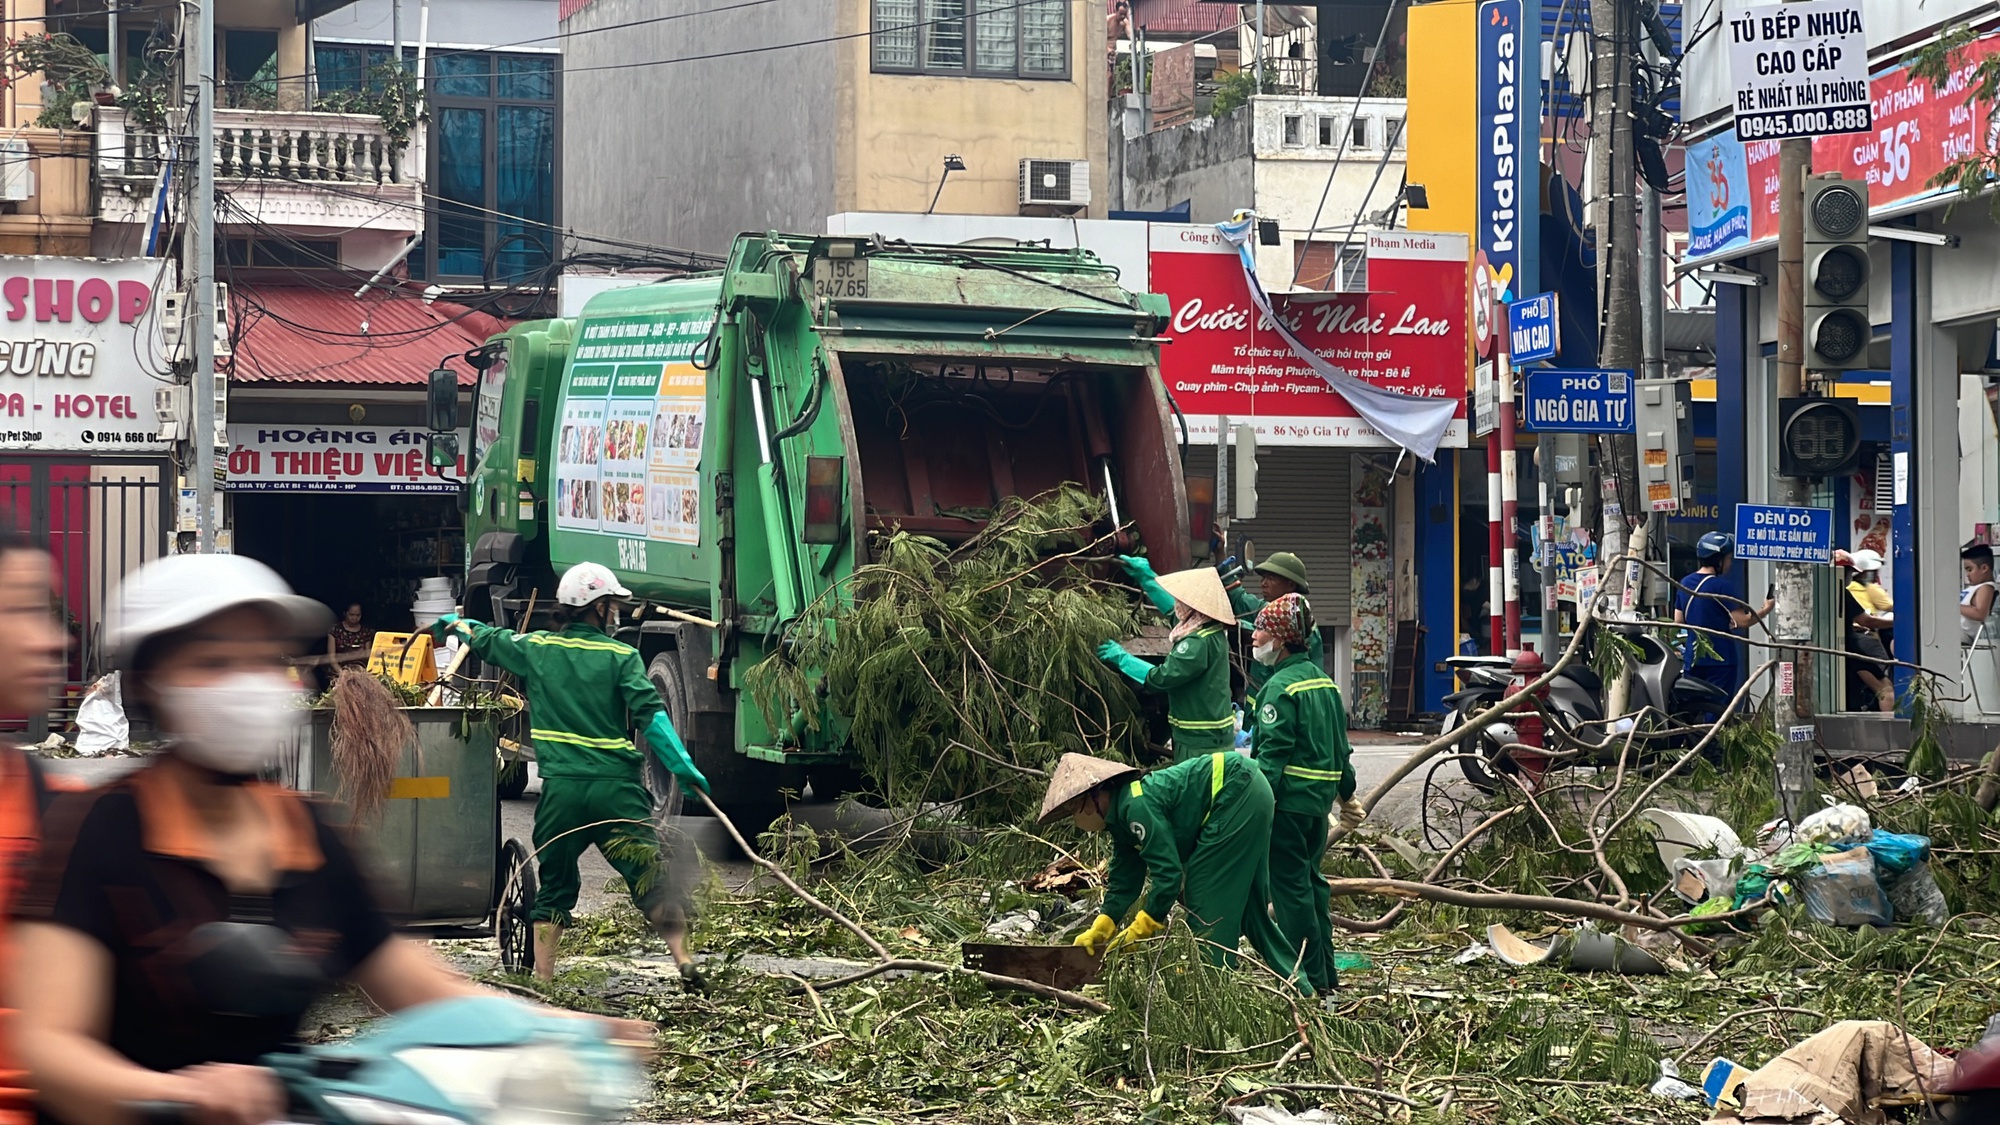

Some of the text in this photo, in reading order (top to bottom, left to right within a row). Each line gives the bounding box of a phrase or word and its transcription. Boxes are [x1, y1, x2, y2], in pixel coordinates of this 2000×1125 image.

[1730, 8, 1863, 43] TỦ BẾP NHỰA
[1756, 39, 1842, 76] CAO CẤP
[1738, 76, 1866, 111] RẺ NHẤT HẢI PHÒNG
[1894, 78, 1924, 112] PHẨM
[1740, 108, 1868, 138] 0945.000.888
[1949, 104, 1970, 127] MUA
[1492, 33, 1514, 252] KidsPlaza
[1853, 137, 1879, 166] GIẢM
[1865, 163, 1881, 186] ĐẾN
[1180, 230, 1222, 246] Công ty
[1369, 236, 1436, 251] Phạm Media
[829, 261, 855, 278] 15C
[816, 280, 865, 297] 347.65
[3, 276, 152, 324] SHOP
[1173, 298, 1248, 333] Cưới
[1312, 303, 1384, 334] Mai
[1388, 304, 1450, 336] Lan
[1521, 299, 1539, 320] PHỐ
[1512, 324, 1550, 355] VĂN CAO
[1233, 344, 1247, 357] Tổ
[1247, 346, 1271, 357] chức
[1272, 347, 1286, 359] sự
[1313, 347, 1392, 362] Cưới hỏi trọn gói
[1211, 364, 1321, 379] Mâm tráp Rồng Phượng
[1348, 369, 1359, 377] xe
[1361, 368, 1379, 378] hoa
[1385, 368, 1399, 378] Bê
[1401, 366, 1411, 378] lễ
[1176, 381, 1202, 393] Quay
[1203, 381, 1228, 394] phim
[1234, 382, 1260, 394] Chụp
[1261, 381, 1280, 392] ảnh
[1285, 383, 1320, 395] Flycam
[1562, 373, 1601, 390] PHỐ
[1412, 384, 1425, 397] Kỷ
[1428, 384, 1446, 397] yếu
[55, 394, 137, 419] HOTEL
[1535, 394, 1627, 427] NGÔ GIA TỰ
[8, 430, 21, 441] Pet
[97, 431, 122, 442] 0914
[125, 432, 144, 443] 666
[258, 427, 377, 444] HOÀNG
[1273, 426, 1286, 436] 86
[1289, 425, 1310, 438] Ngô
[1313, 426, 1331, 436] Gia
[1335, 426, 1350, 438] Tự
[271, 447, 363, 480] THIỆU
[255, 482, 267, 490] TỰ
[1680, 505, 1708, 518] SINH
[1754, 510, 1811, 527] ĐÈN ĐỎ
[1747, 528, 1755, 540] XE
[1779, 530, 1787, 542] XE
[1788, 527, 1802, 542] GẮN
[1802, 530, 1817, 543] MÁY
[1737, 544, 1745, 555] XE
[1759, 544, 1769, 557] SƠ
[1787, 545, 1804, 558] PHÉP
[1813, 545, 1828, 560] PHẢI
